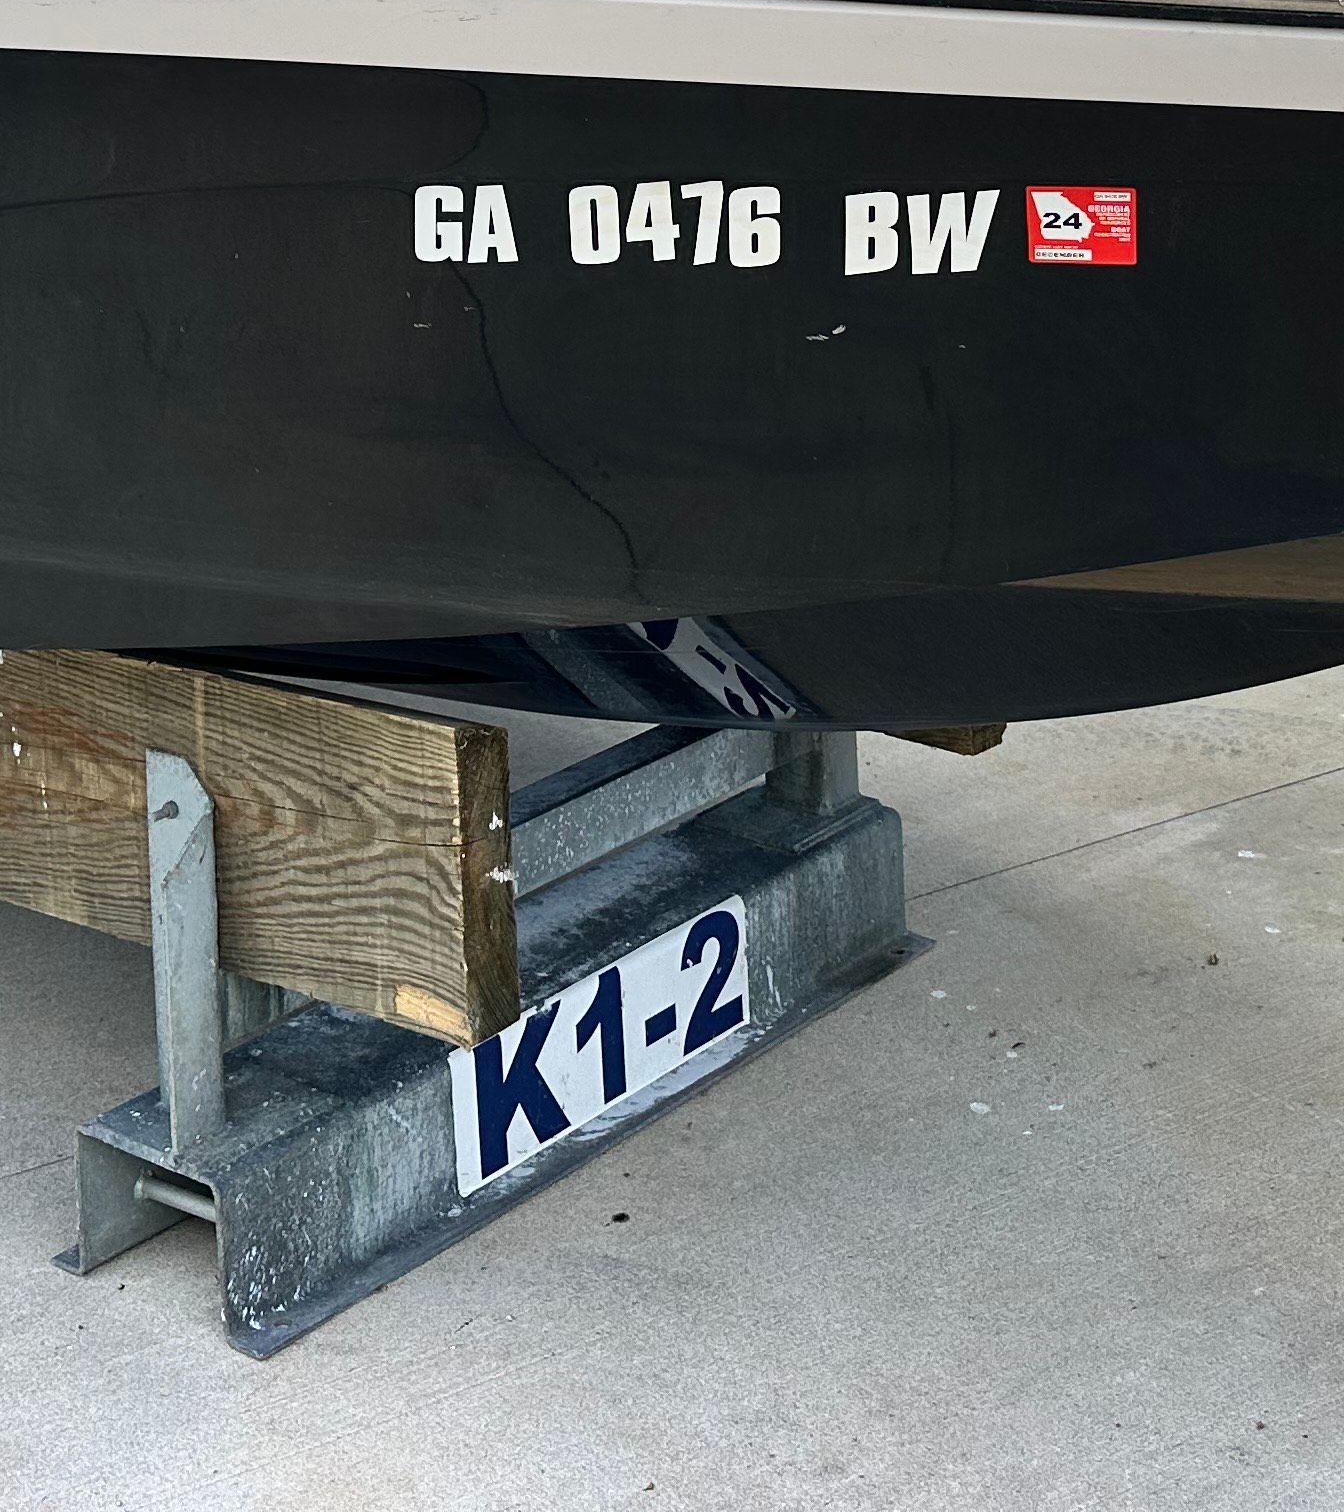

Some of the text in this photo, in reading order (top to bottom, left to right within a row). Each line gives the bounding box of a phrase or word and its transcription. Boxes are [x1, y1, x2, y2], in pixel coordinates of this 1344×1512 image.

[413, 180, 1001, 277] GA 0476 BW
[1042, 212, 1083, 230] 24
[472, 909, 745, 1181] K1-2
